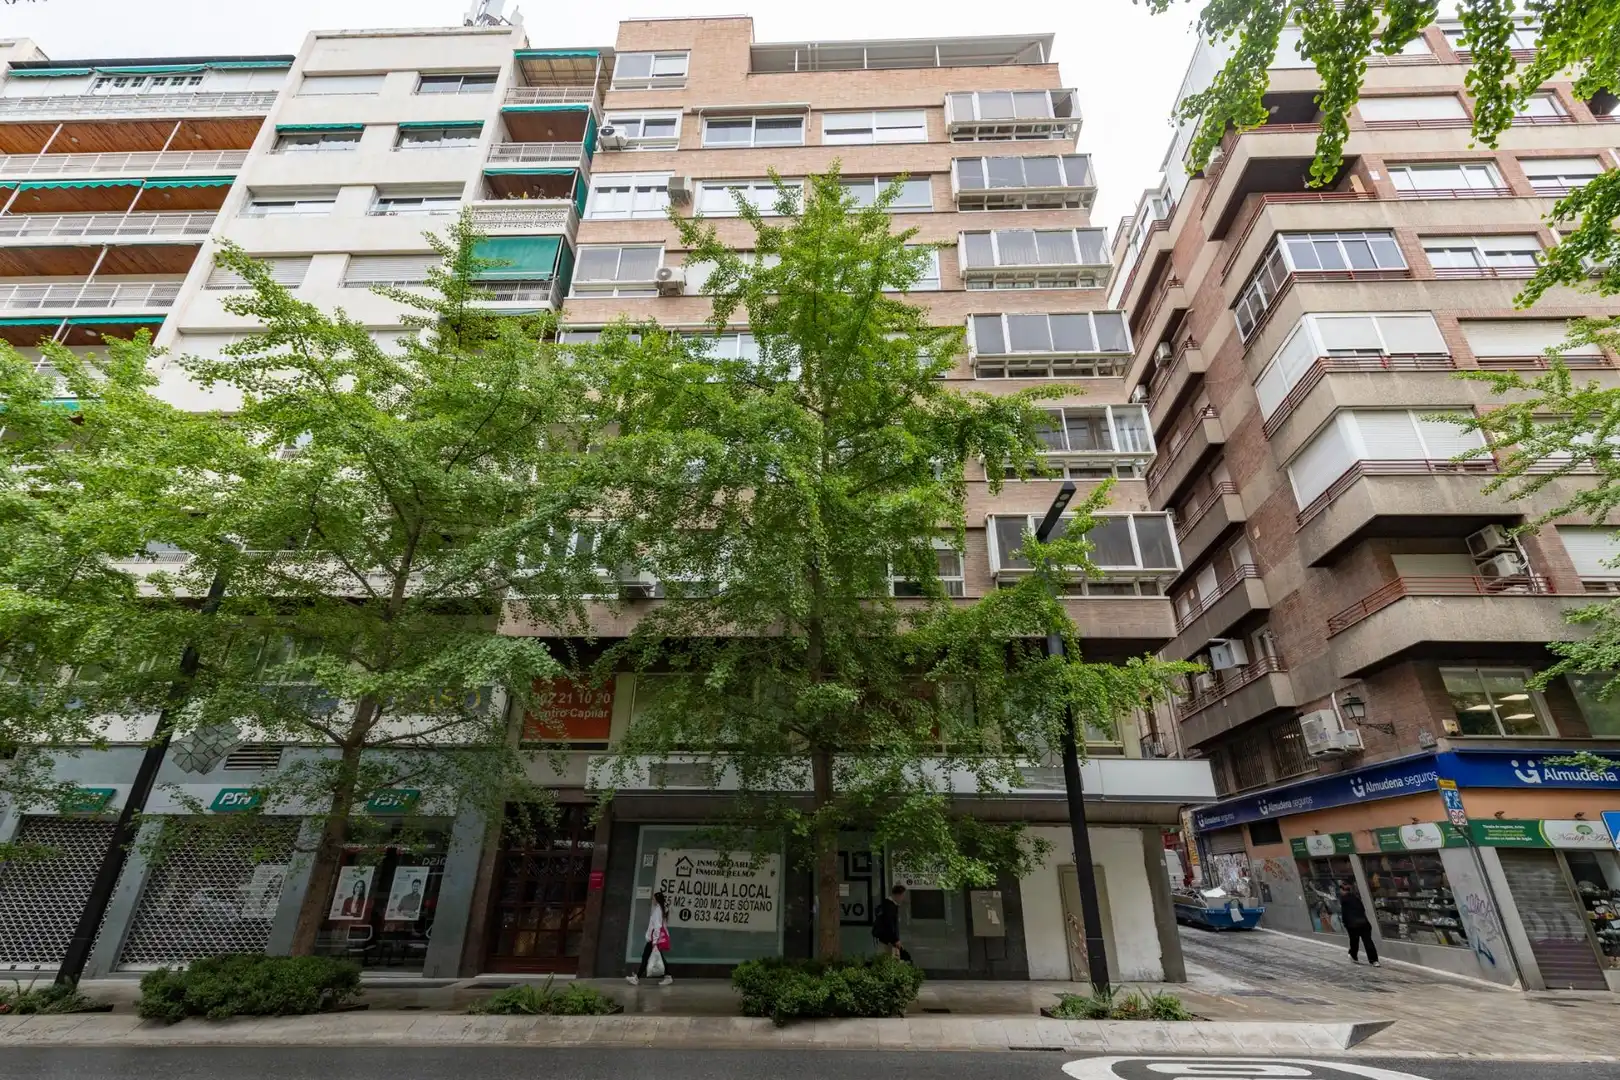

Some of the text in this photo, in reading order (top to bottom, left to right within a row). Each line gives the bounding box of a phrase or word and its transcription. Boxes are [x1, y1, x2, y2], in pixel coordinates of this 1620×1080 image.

[558, 692, 573, 704] 21
[579, 691, 592, 704] 10
[530, 707, 609, 720] Cntro Capilar
[1365, 777, 1404, 793] Almudena
[1404, 770, 1438, 787] seguros
[1544, 767, 1619, 782] Almudena
[219, 792, 251, 805] PSN
[1268, 796, 1313, 813] Almudena seguros
[660, 879, 771, 899] SE ALQUILA LOCAL
[674, 897, 686, 907] M2
[694, 898, 708, 909] 200
[710, 899, 722, 910] M2
[724, 900, 736, 911] DE
[738, 898, 773, 912] SÓTANO
[694, 910, 750, 924] 633 424 622
